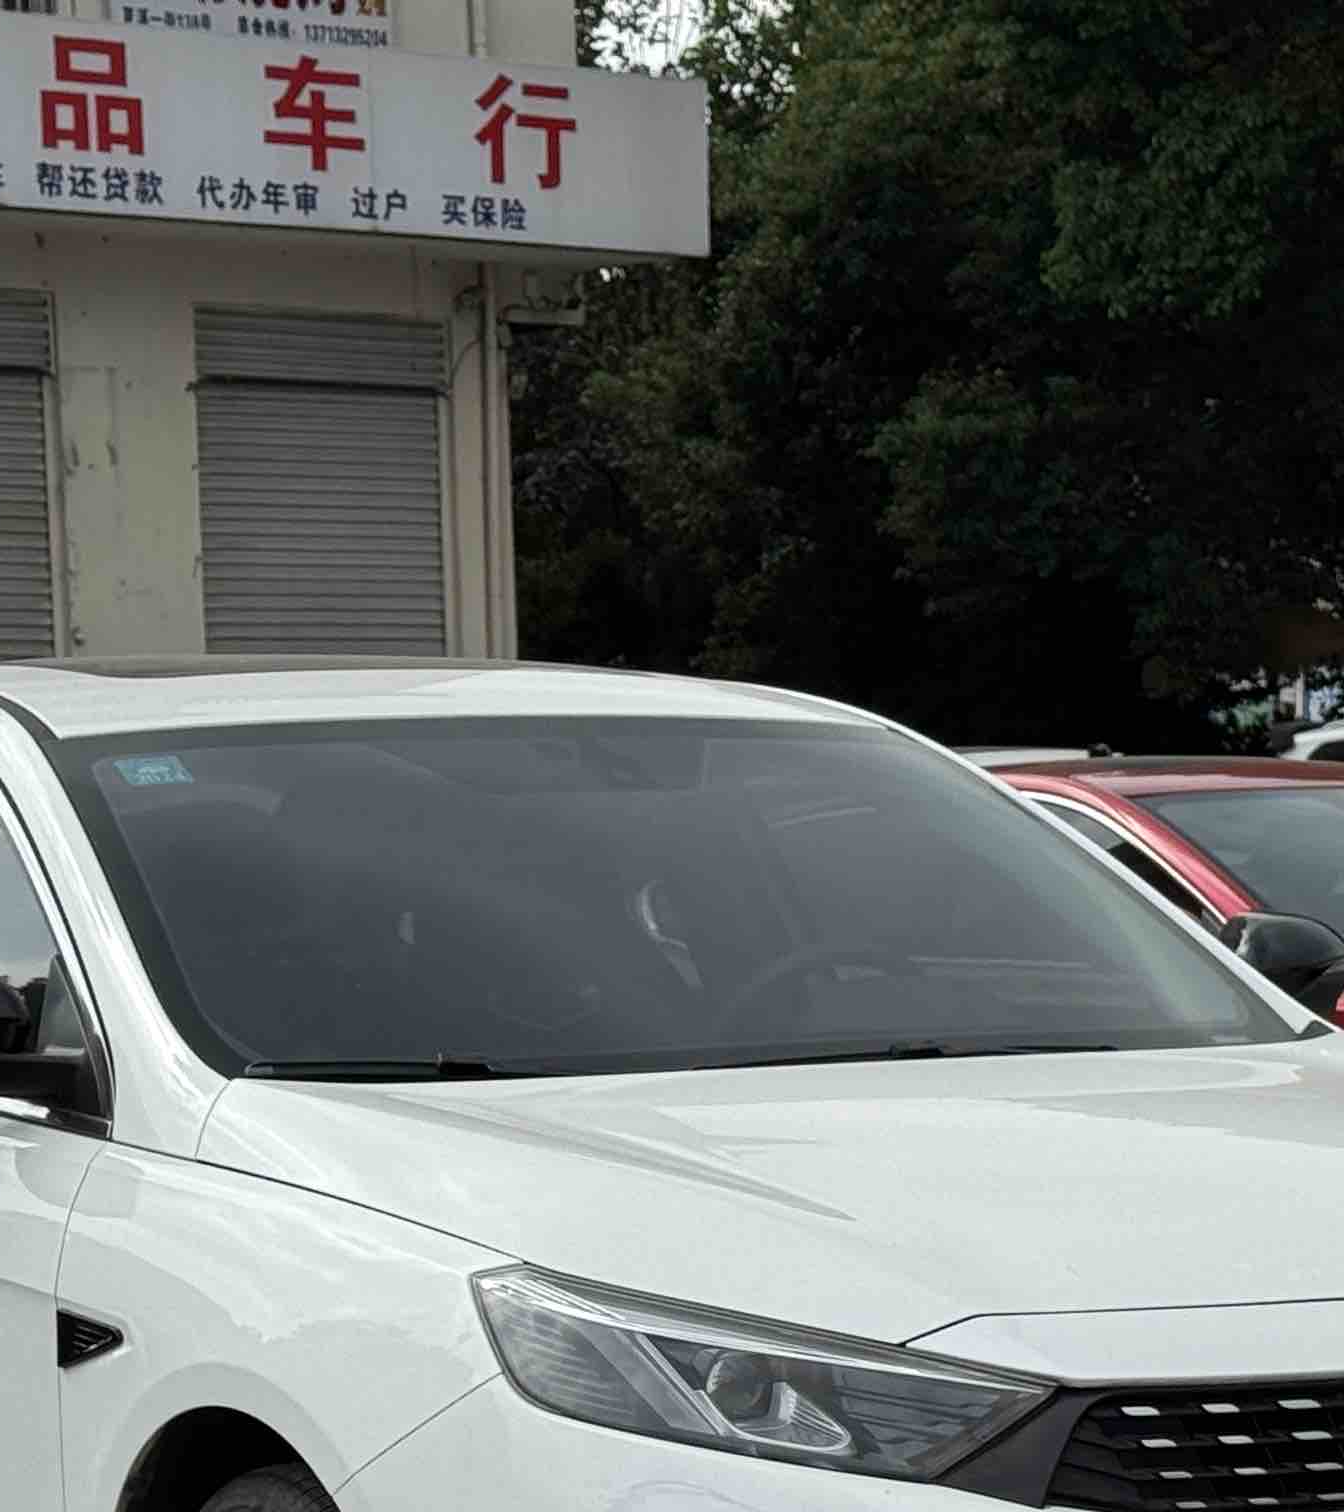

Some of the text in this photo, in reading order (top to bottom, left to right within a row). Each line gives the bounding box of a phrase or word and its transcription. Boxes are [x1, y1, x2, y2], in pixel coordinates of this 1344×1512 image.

[36, 161, 164, 205] 帮还贷款
[197, 176, 319, 215] 代办年审
[352, 187, 407, 220] 过户
[442, 194, 527, 231] 买保险
